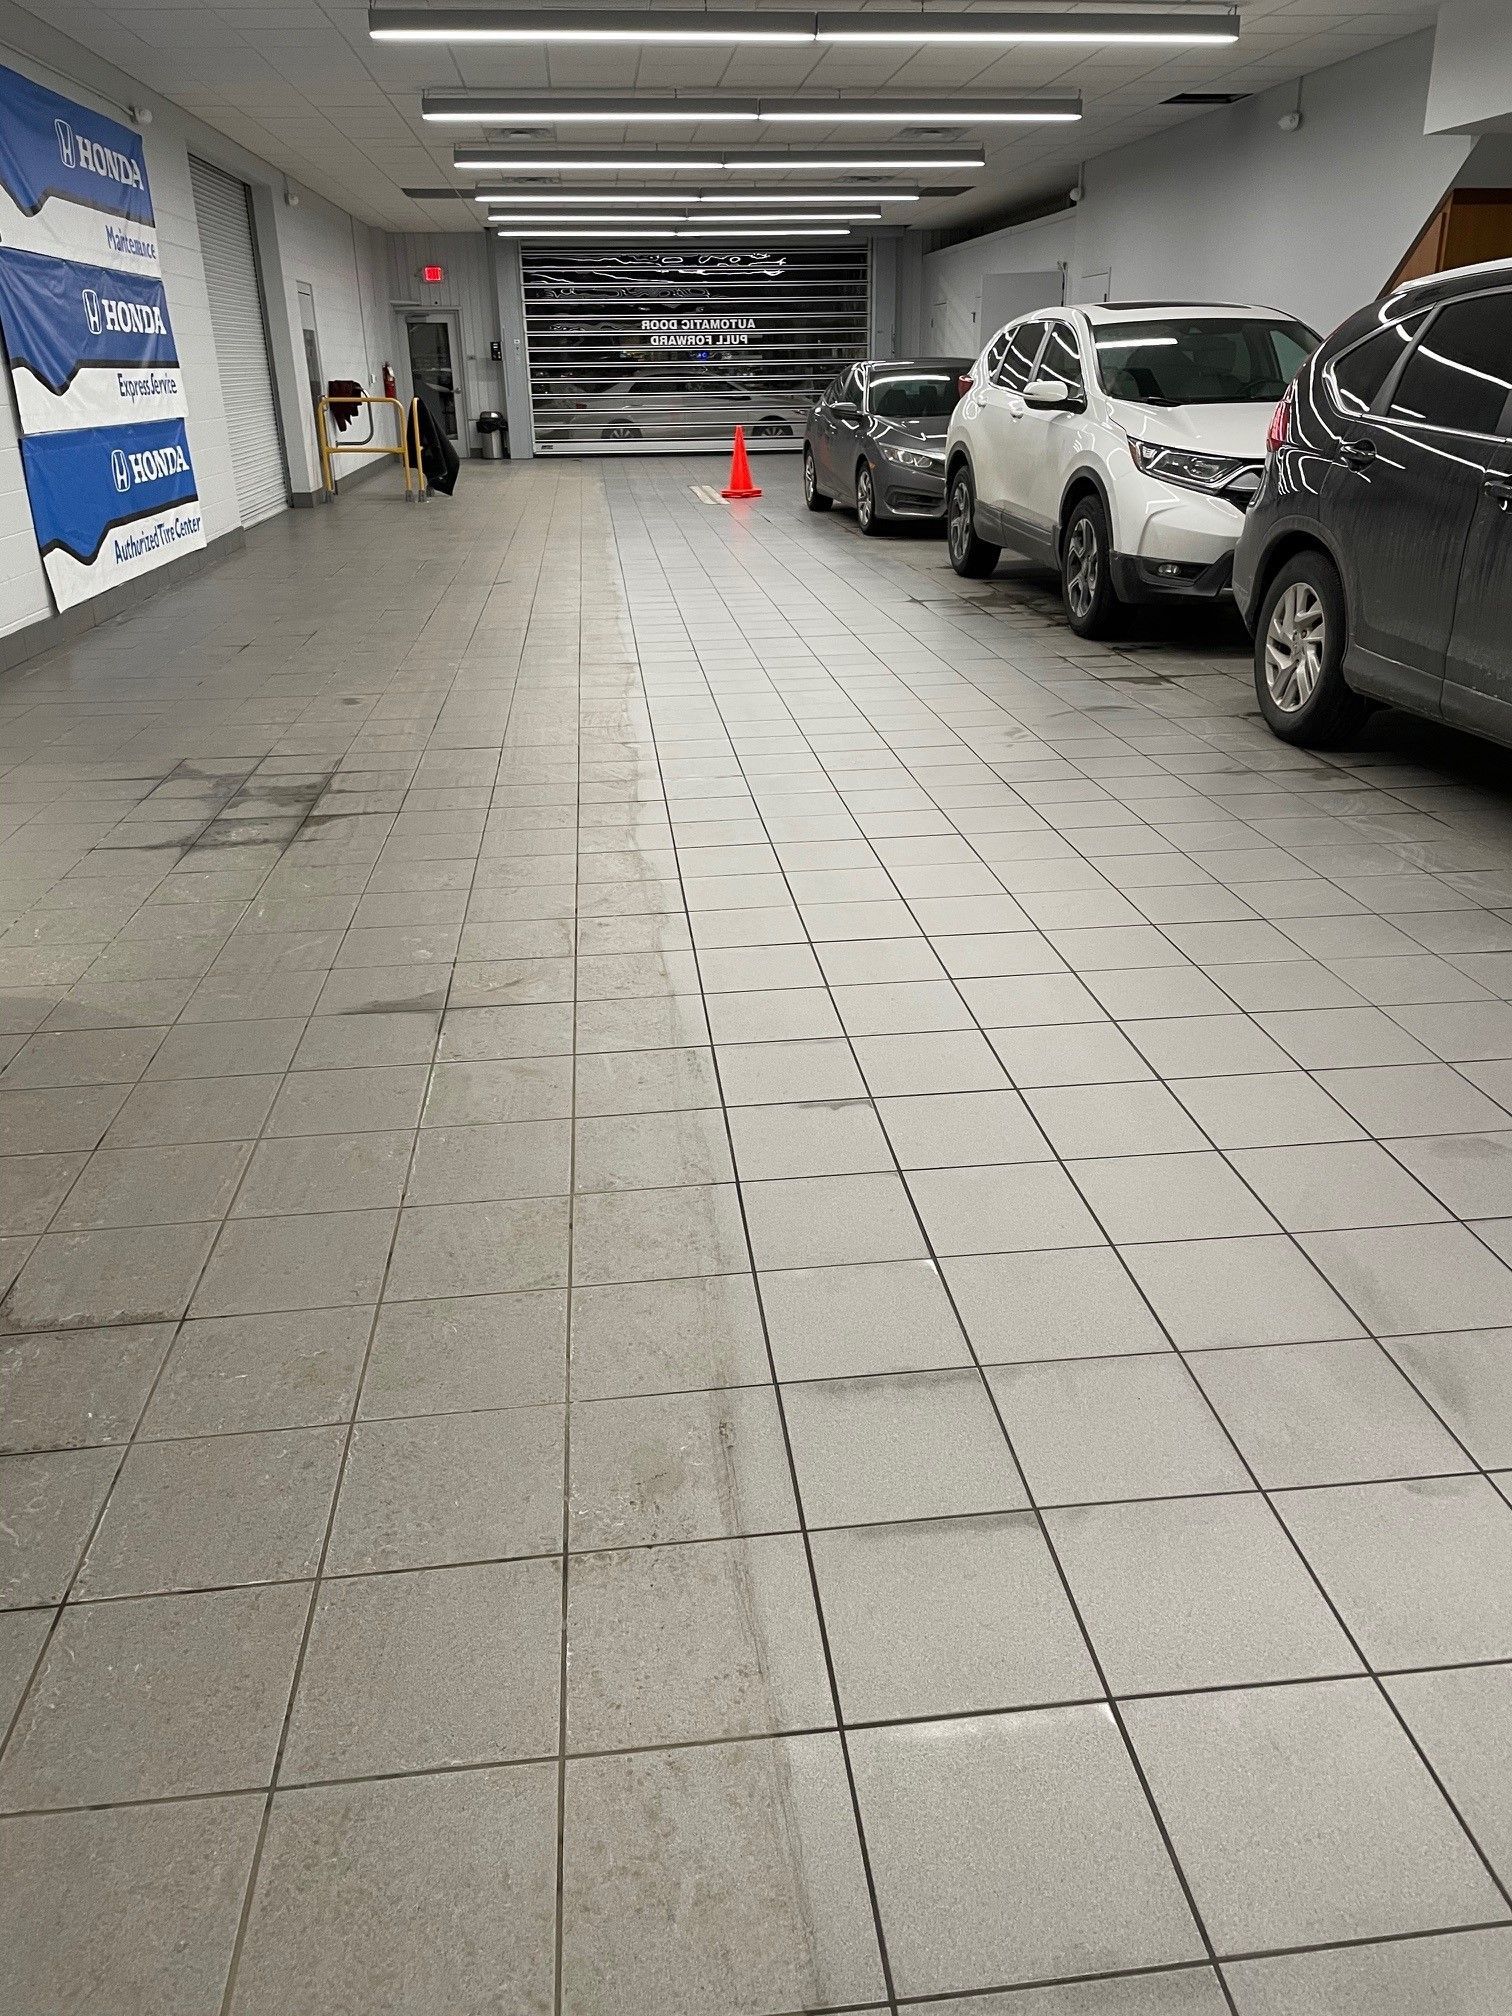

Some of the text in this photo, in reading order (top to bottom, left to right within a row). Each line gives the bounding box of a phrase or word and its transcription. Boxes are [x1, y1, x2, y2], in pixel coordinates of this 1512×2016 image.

[75, 135, 144, 191] HONDA
[105, 225, 157, 260] Maintenance
[102, 299, 167, 335] HONDA
[117, 372, 178, 404] Express Service
[128, 445, 190, 484] HONDA
[114, 517, 201, 565] Authorized Tire Center
